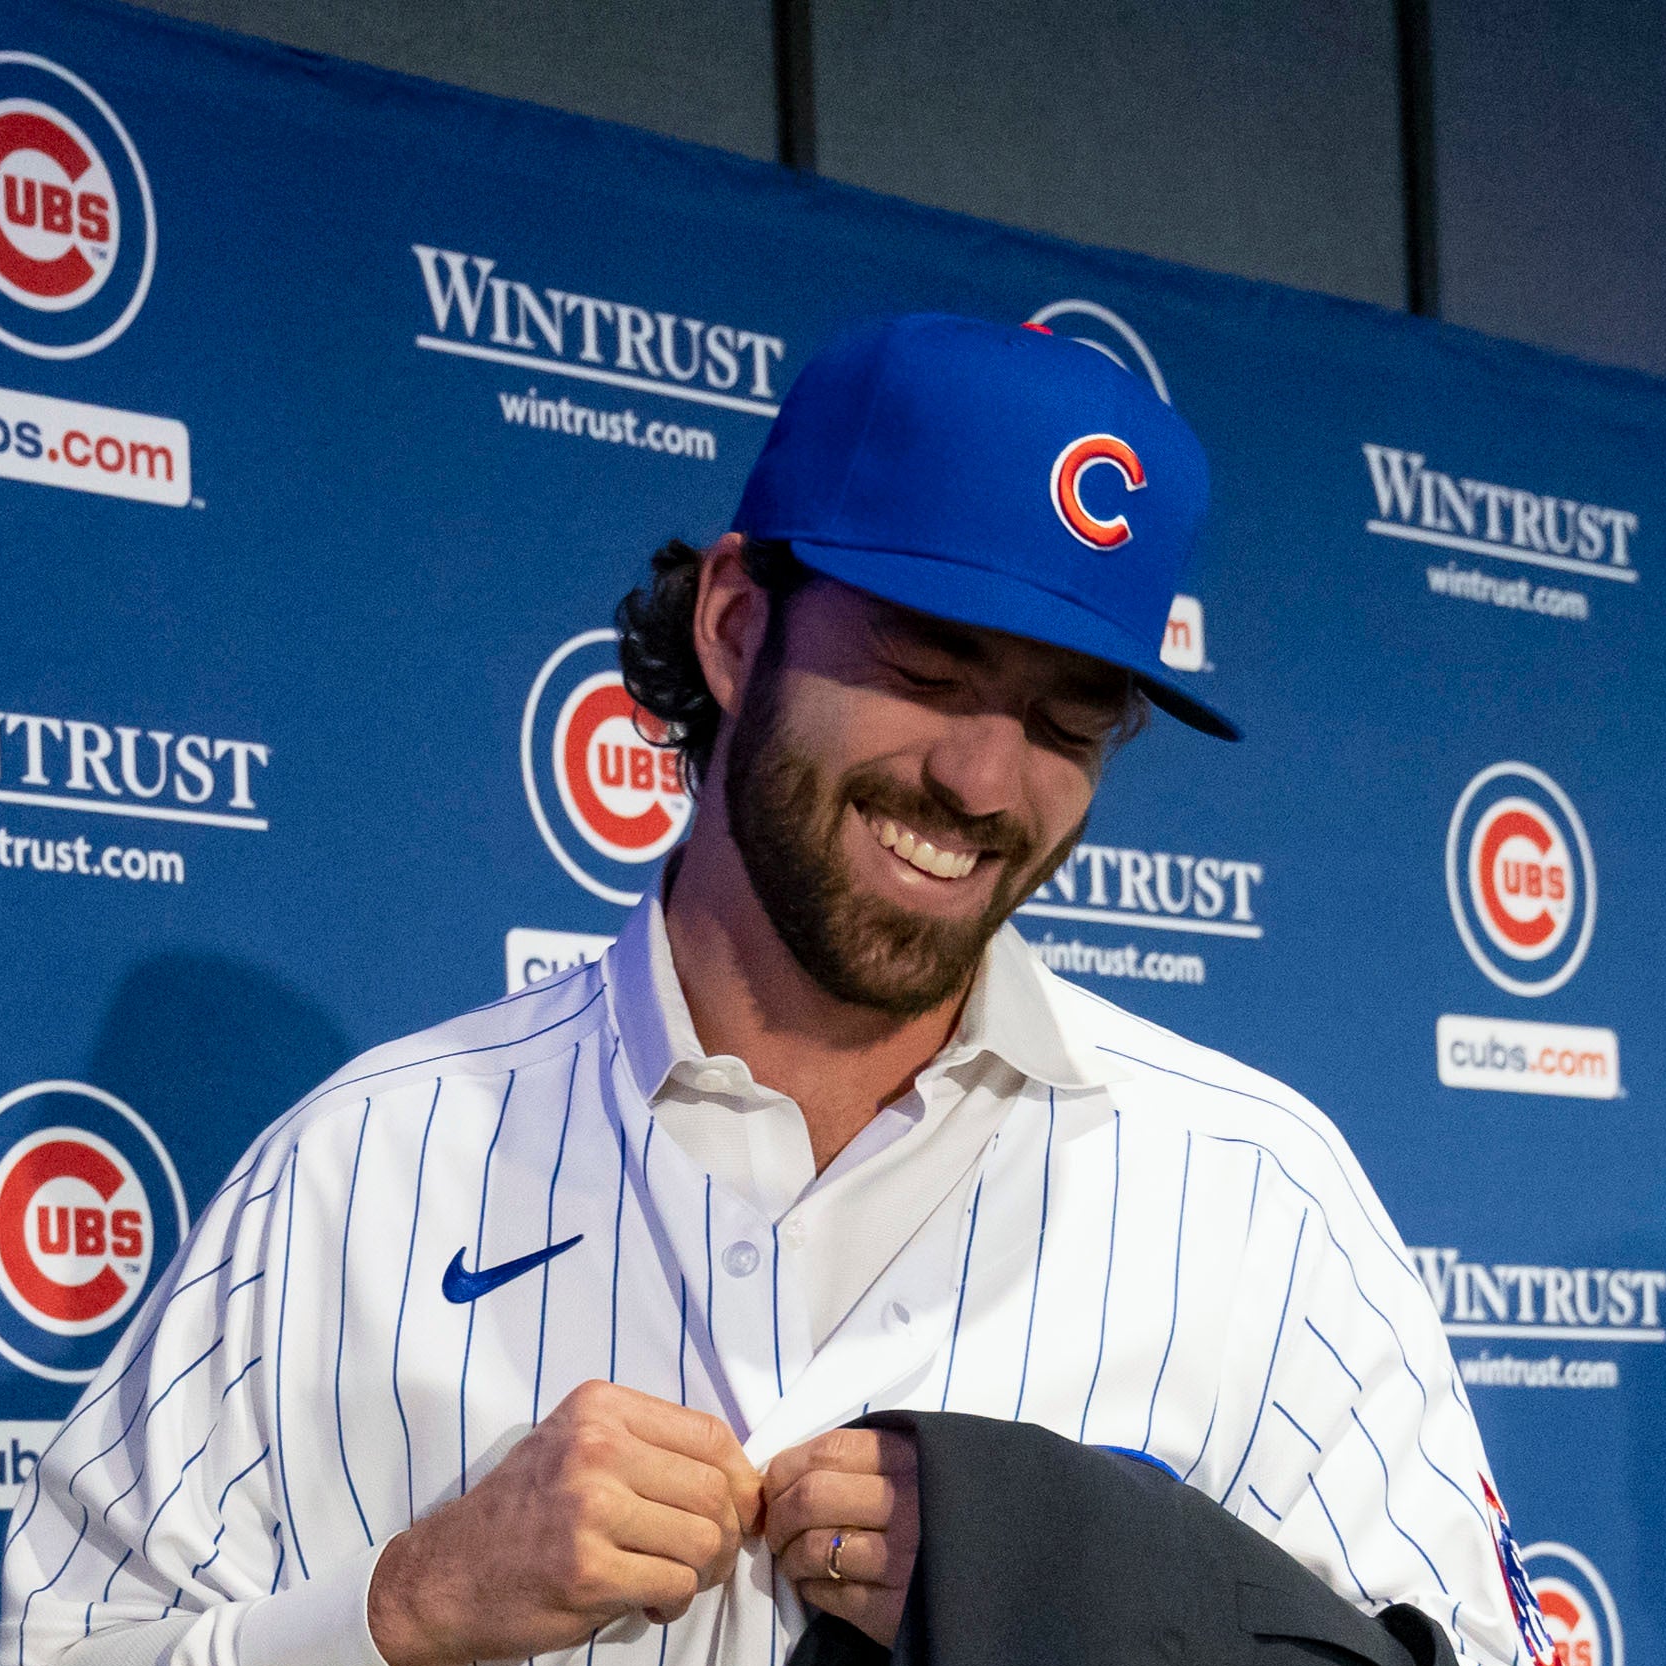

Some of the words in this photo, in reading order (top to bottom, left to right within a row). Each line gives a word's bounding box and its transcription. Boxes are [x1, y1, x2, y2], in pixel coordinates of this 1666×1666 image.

[412, 244, 785, 399] WINTRUST
[499, 391, 716, 460] wintrust.com
[1050, 434, 1147, 551] C
[1363, 443, 1637, 567] WINTRUST
[1428, 563, 1588, 620] wintrust.com
[1479, 809, 1564, 947] CUBS
[1449, 1035, 1608, 1079] cubs.com
[1460, 1350, 1618, 1388] wintrust.com
